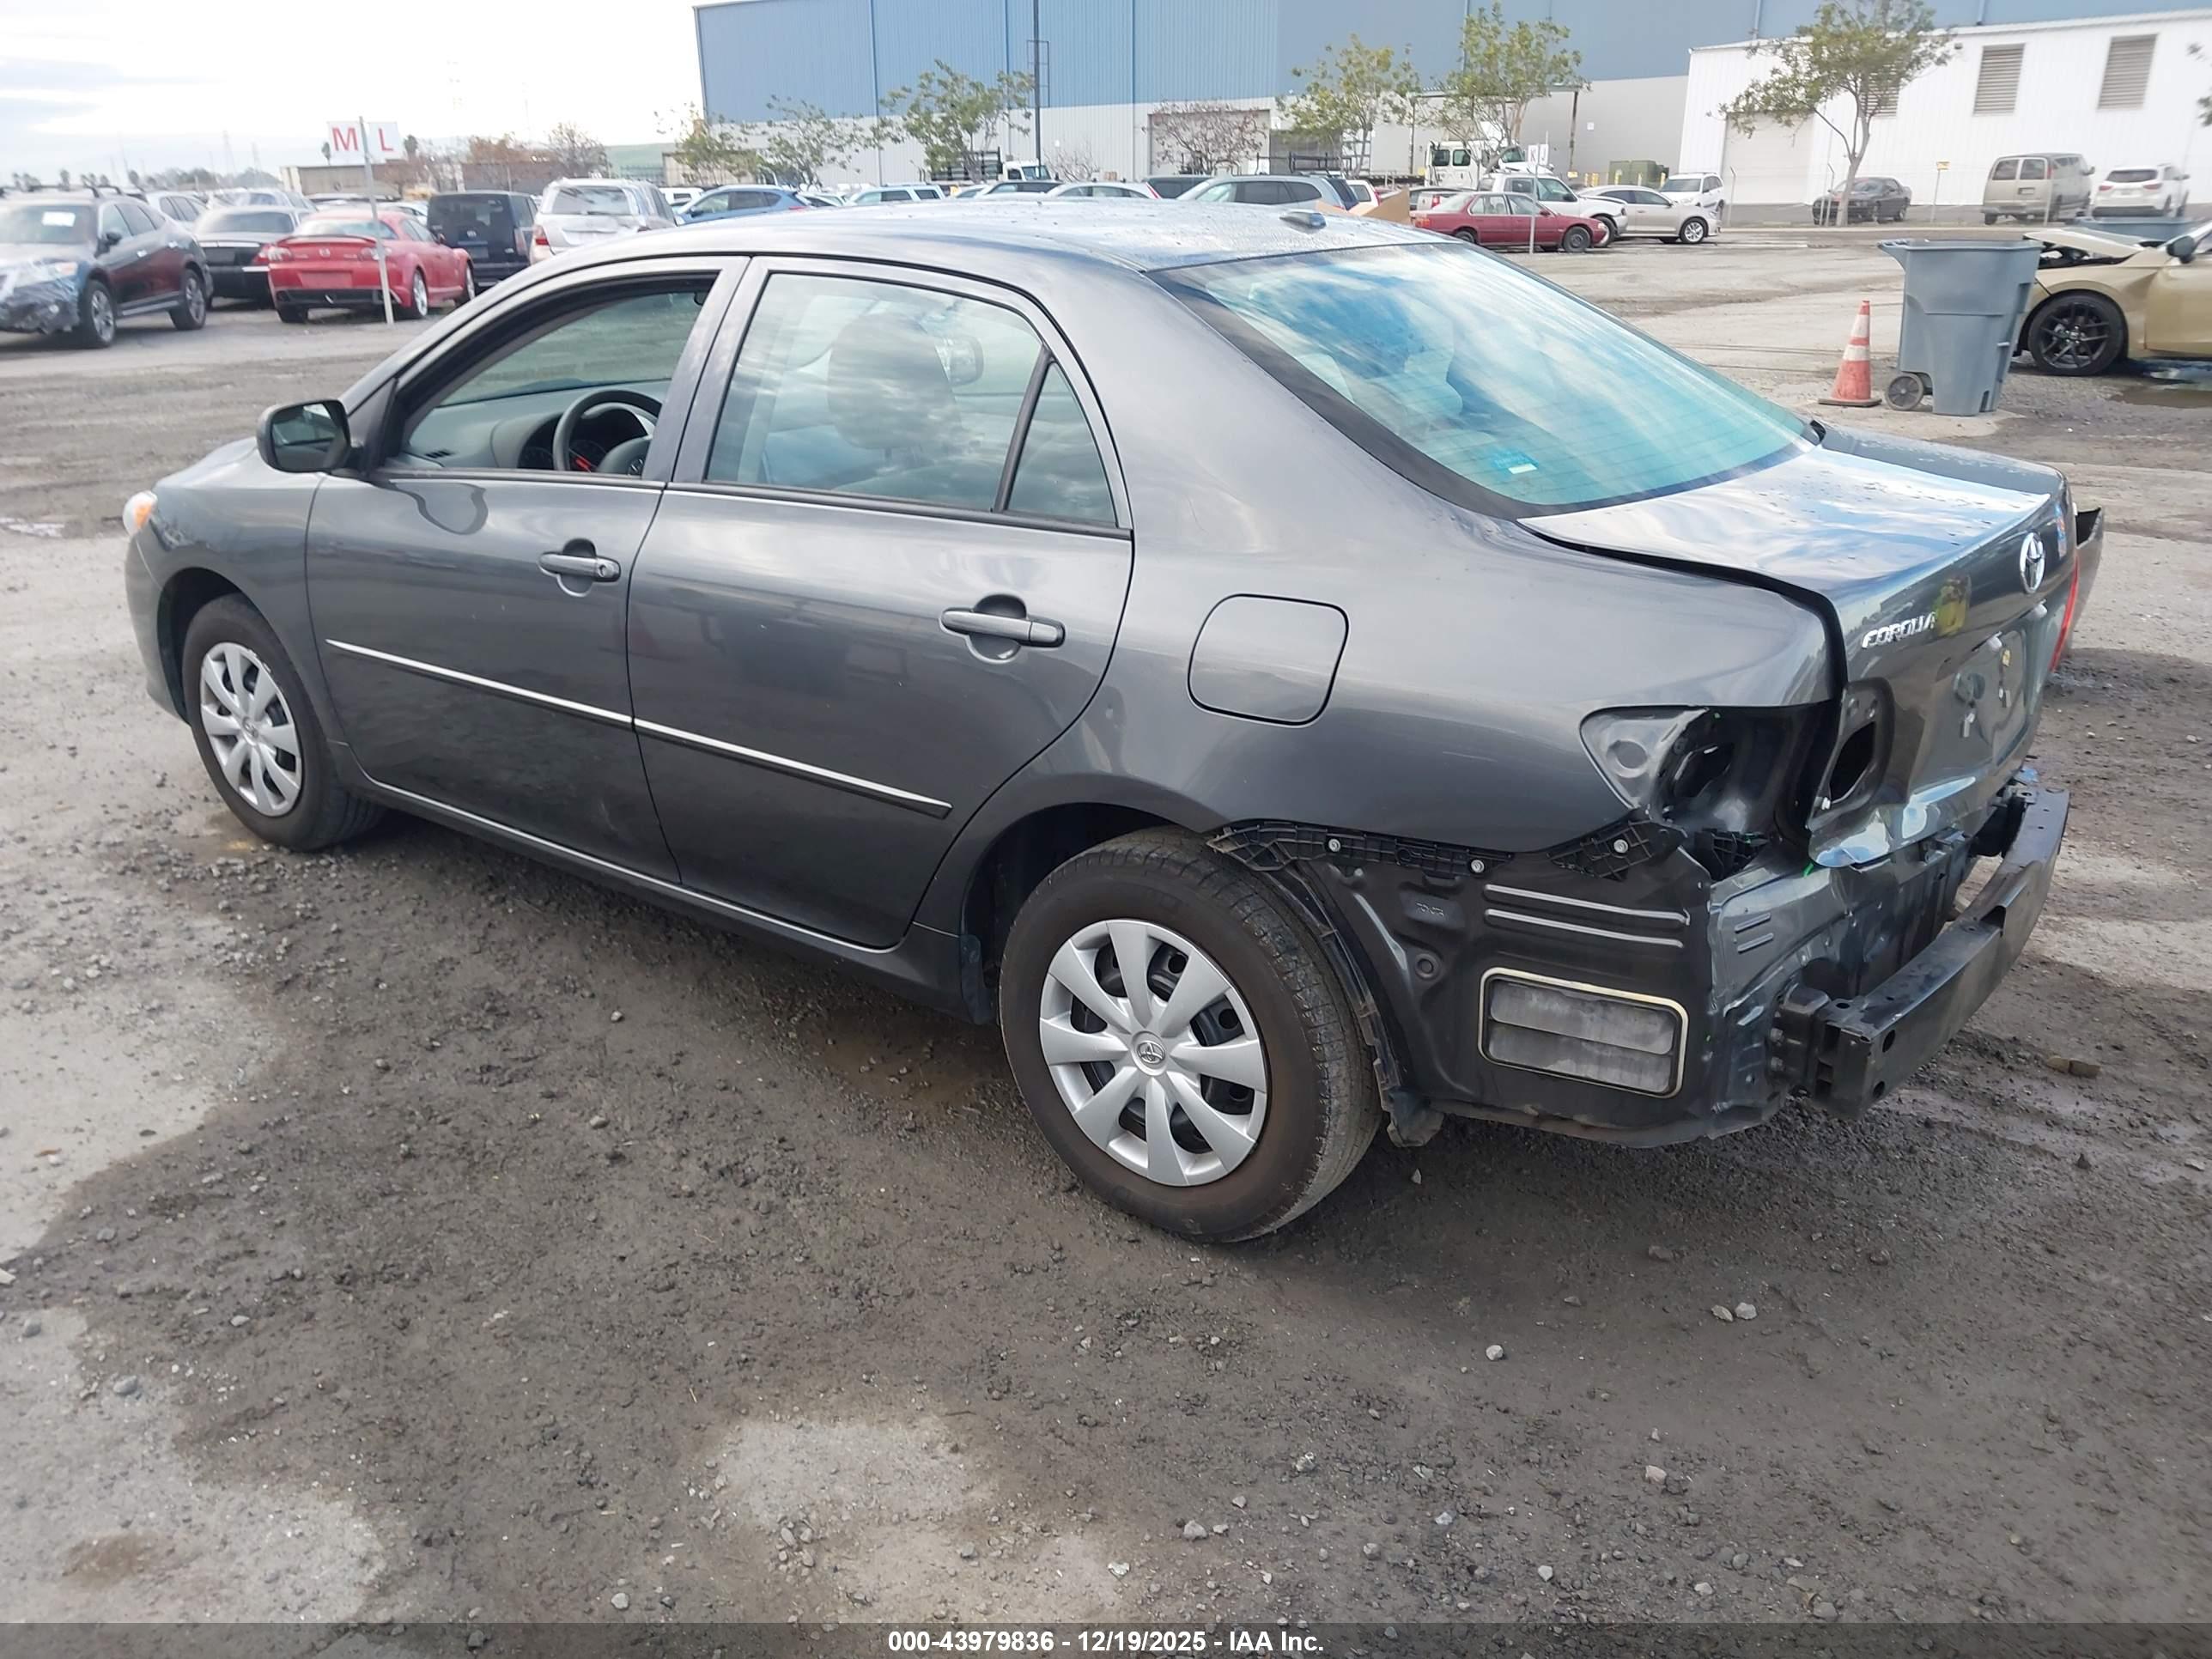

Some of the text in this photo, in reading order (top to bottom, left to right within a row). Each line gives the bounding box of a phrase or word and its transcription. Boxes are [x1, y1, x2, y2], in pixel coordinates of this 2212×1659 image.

[331, 127, 359, 152] M
[378, 127, 394, 152] L
[1862, 611, 1936, 649] COROLLA
